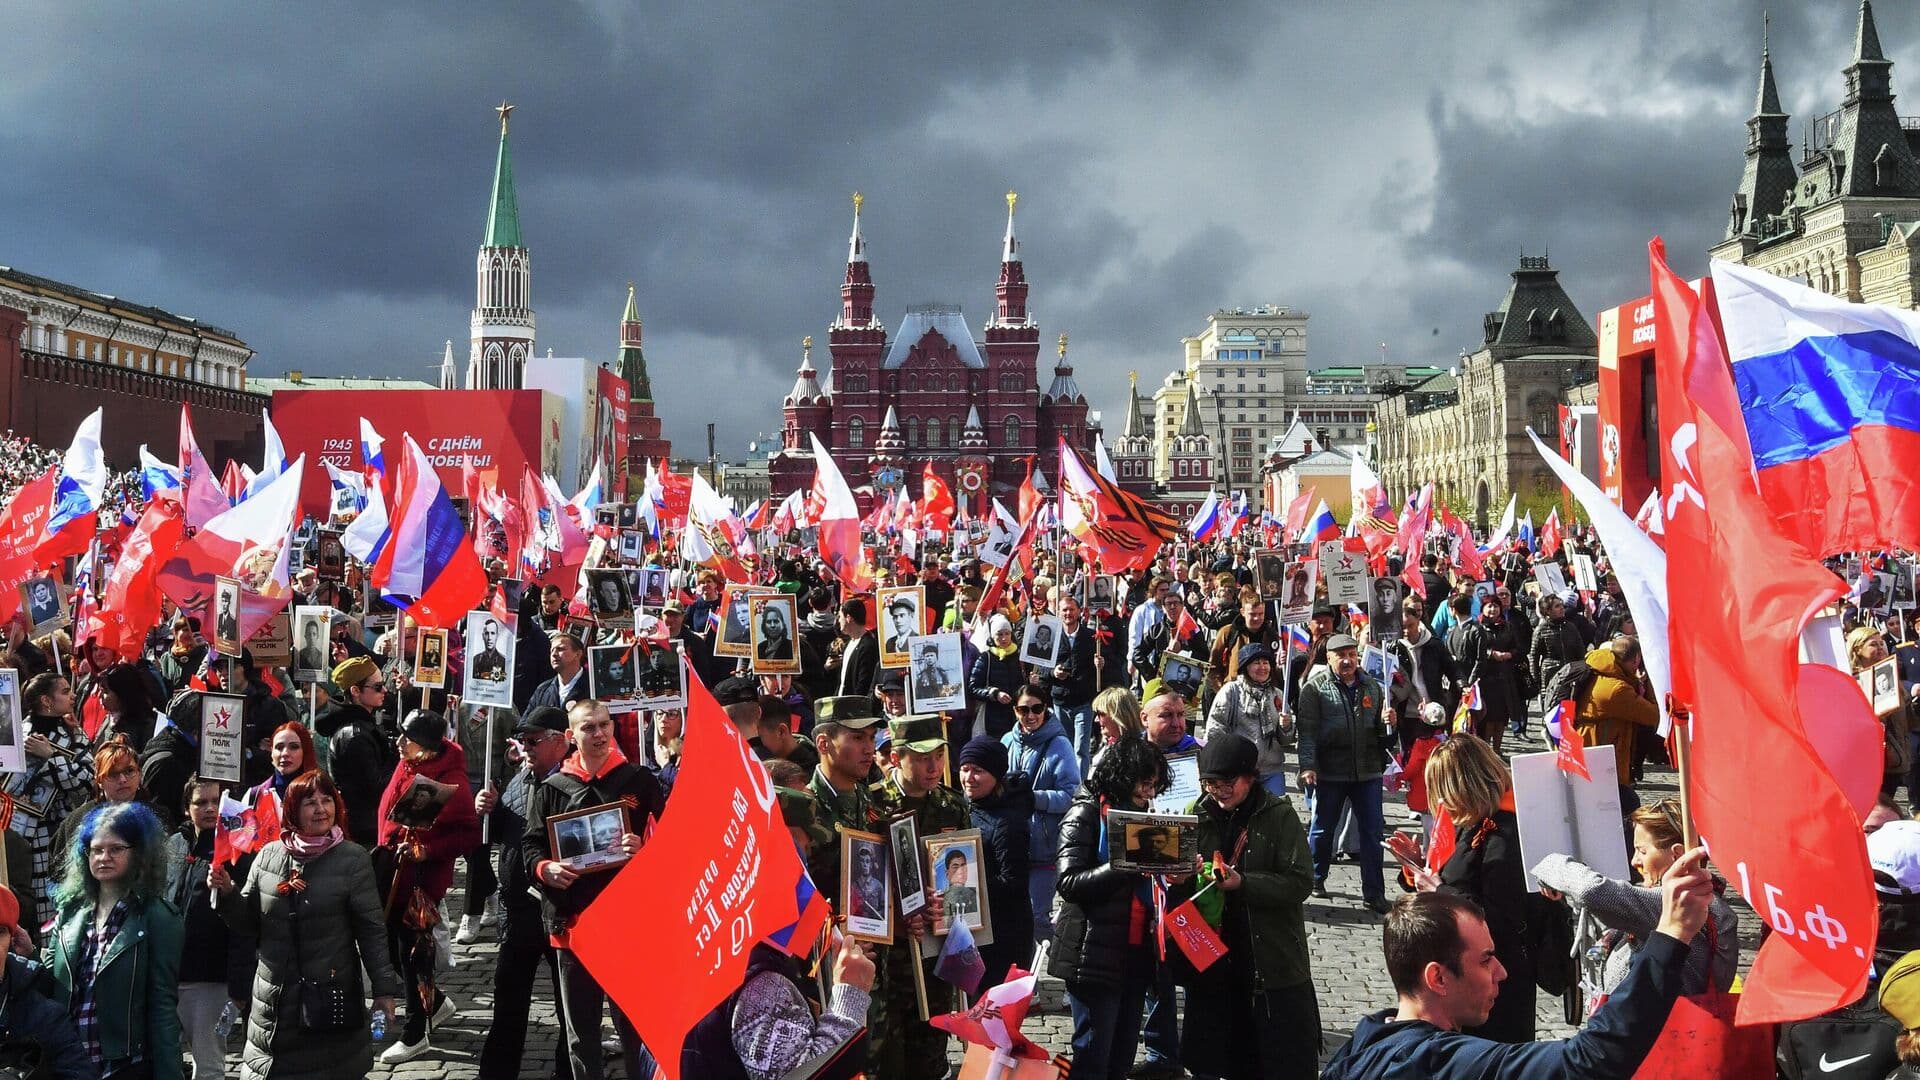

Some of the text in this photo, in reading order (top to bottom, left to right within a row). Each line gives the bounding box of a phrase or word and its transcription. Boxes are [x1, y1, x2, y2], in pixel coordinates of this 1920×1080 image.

[323, 439, 353, 450] 1945
[428, 434, 482, 452] С ДНЁМ
[317, 455, 351, 467] 2022
[212, 738, 231, 747] ПОЛК
[1763, 882, 1865, 959] Б.Ф.
